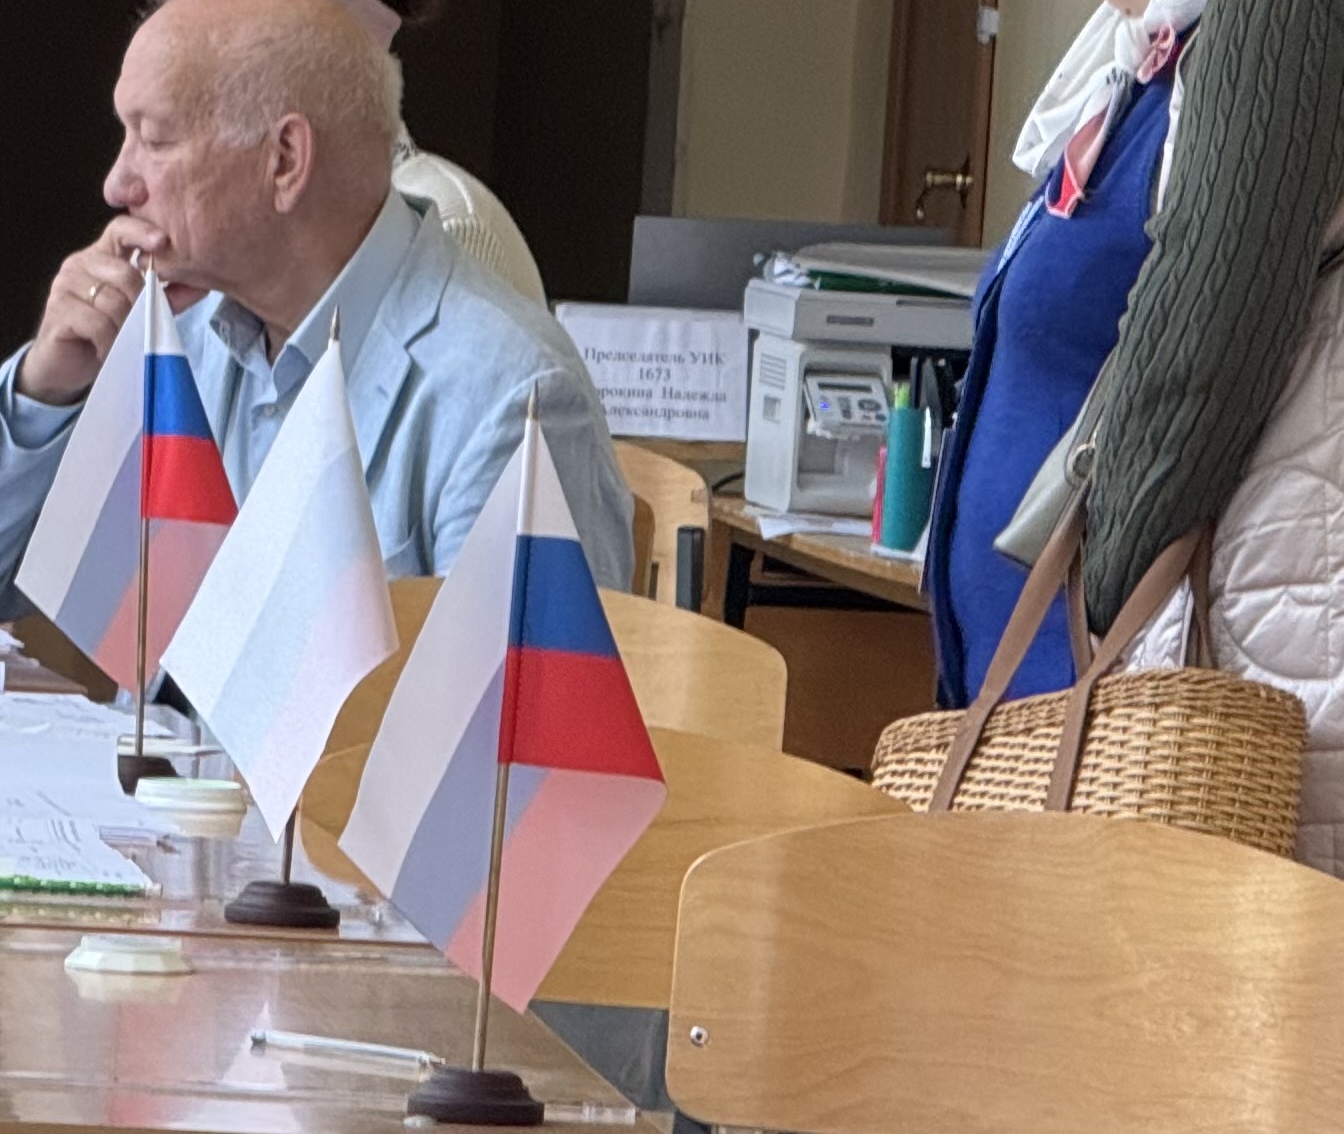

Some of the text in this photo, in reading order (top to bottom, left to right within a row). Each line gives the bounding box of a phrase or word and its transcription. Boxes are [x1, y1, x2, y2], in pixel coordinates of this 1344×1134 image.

[584, 347, 726, 366] Председатель УИК
[638, 367, 672, 381] 1673
[662, 386, 727, 403] Надежда
[605, 405, 710, 421] лександровна
